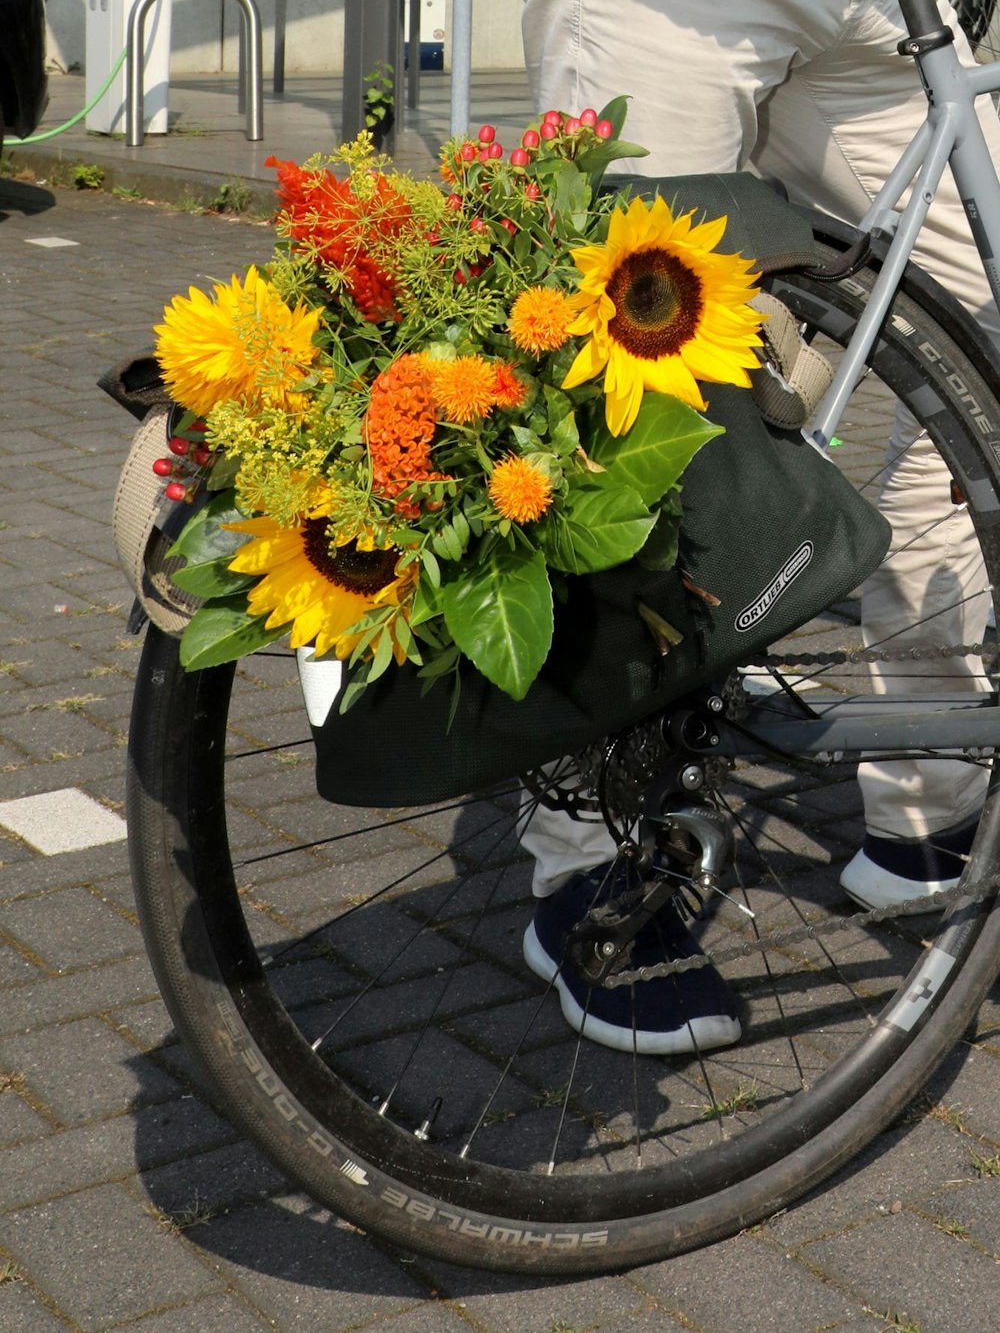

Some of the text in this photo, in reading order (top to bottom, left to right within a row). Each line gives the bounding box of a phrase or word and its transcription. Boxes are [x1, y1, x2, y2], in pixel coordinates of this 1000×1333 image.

[918, 341, 995, 435] G-ONE
[741, 580, 781, 625] ORTLIEB
[240, 1048, 334, 1157] G-ONE
[381, 1186, 609, 1249] SCHWALBE
